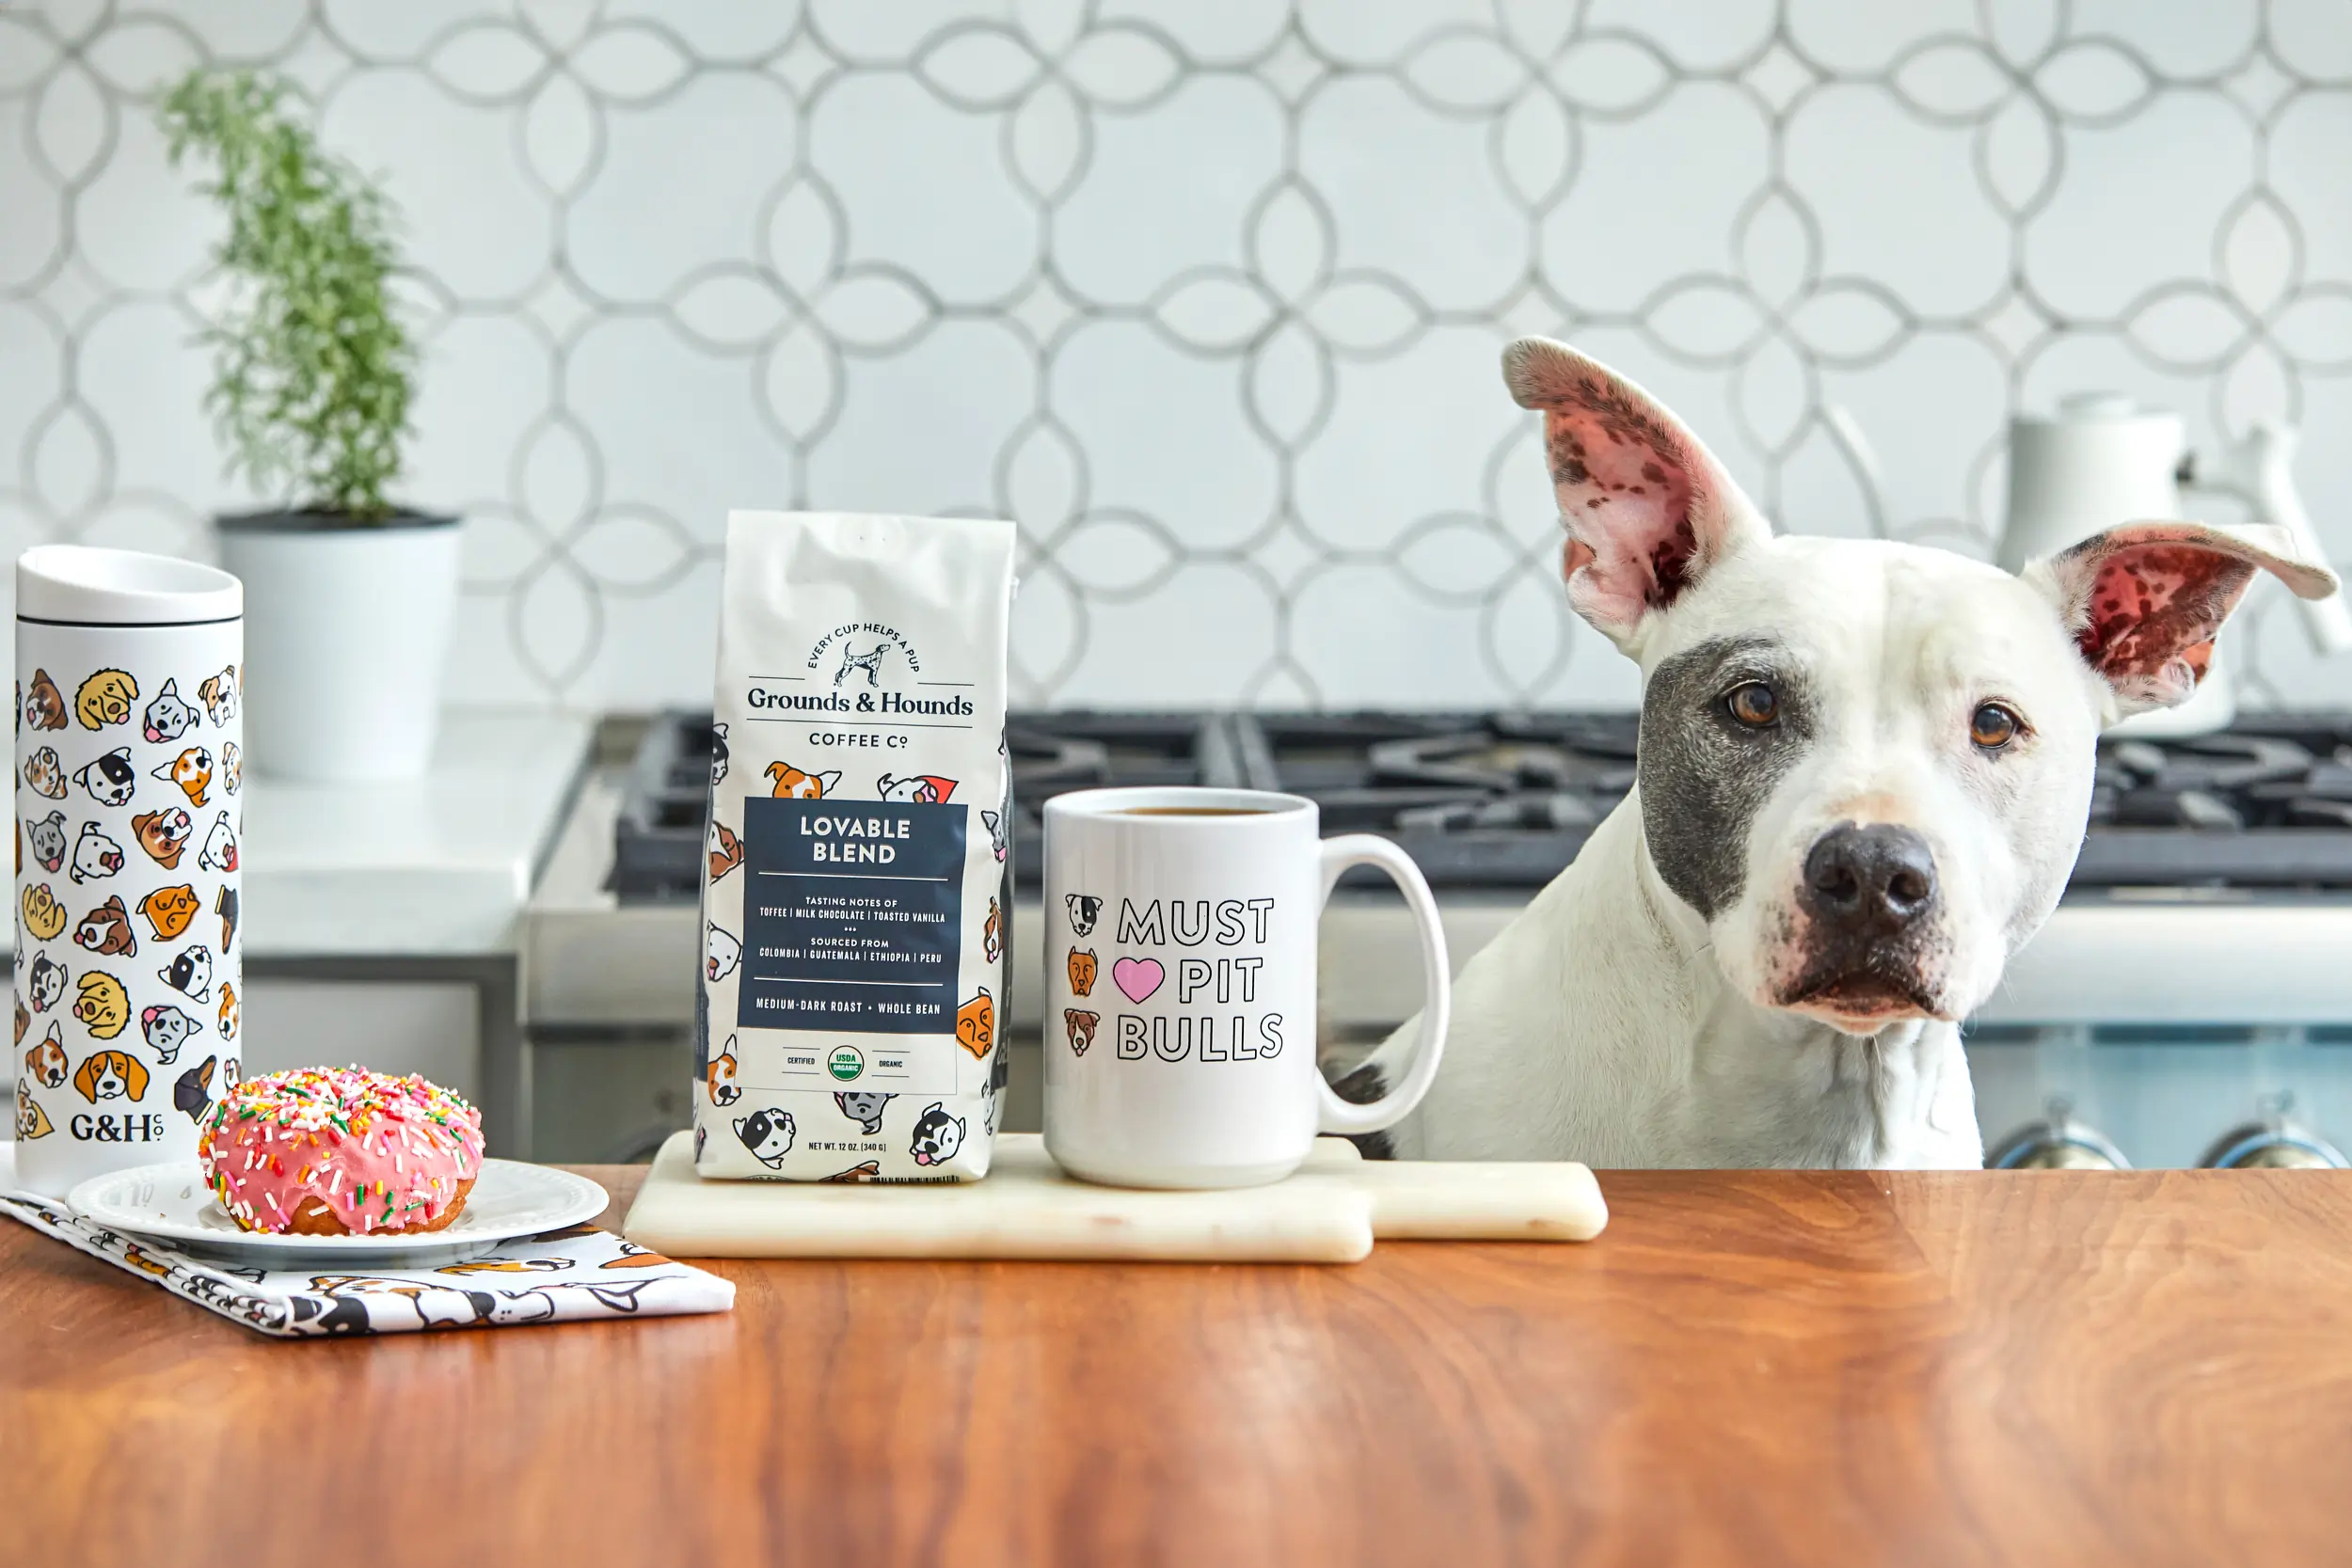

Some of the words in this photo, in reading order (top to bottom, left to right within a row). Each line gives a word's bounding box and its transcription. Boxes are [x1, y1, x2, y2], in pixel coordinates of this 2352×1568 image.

[808, 634, 834, 669] EVERY
[834, 624, 859, 637] CUP
[863, 623, 900, 641] HELPS
[898, 641, 907, 649] A
[905, 649, 920, 673] PUP
[747, 688, 850, 712] Grounds
[855, 692, 875, 713] &
[881, 692, 974, 716] Hounds
[809, 733, 880, 748] COFFEE
[801, 816, 911, 839] LOVABLE
[813, 843, 896, 863] BLEND
[805, 896, 846, 906] TASTING
[850, 898, 882, 907] NOTES
[884, 899, 898, 908] OF
[760, 907, 787, 917] TOFFEE
[796, 909, 816, 918] MILK
[818, 910, 865, 921] CHOCOLATE
[874, 911, 910, 922] TOASTED
[913, 912, 946, 923] VANILLA
[1117, 897, 1274, 946] MUST
[810, 938, 857, 947] SOURCED
[861, 939, 889, 948] FROM
[759, 947, 800, 958] COLOMBIA
[810, 950, 860, 960] GUATEMALA
[870, 952, 910, 962] ETHIOPIA
[920, 953, 942, 963] PERU
[1179, 958, 1263, 1004] PIT
[756, 997, 826, 1011] MEDIUM-DARK
[831, 1000, 863, 1013] ROAST
[878, 1002, 911, 1014] WHOLE
[915, 1004, 940, 1015] BEAN
[1117, 1013, 1283, 1062] BULLS
[787, 1056, 815, 1065] CERTIFIED
[836, 1053, 856, 1063] USDA
[833, 1064, 858, 1072] ORGANIC
[71, 1114, 151, 1142] G&H
[808, 1142, 822, 1150] NET
[824, 1142, 836, 1150] WT.
[838, 1143, 846, 1151] 12
[848, 1143, 859, 1151] OZ.
